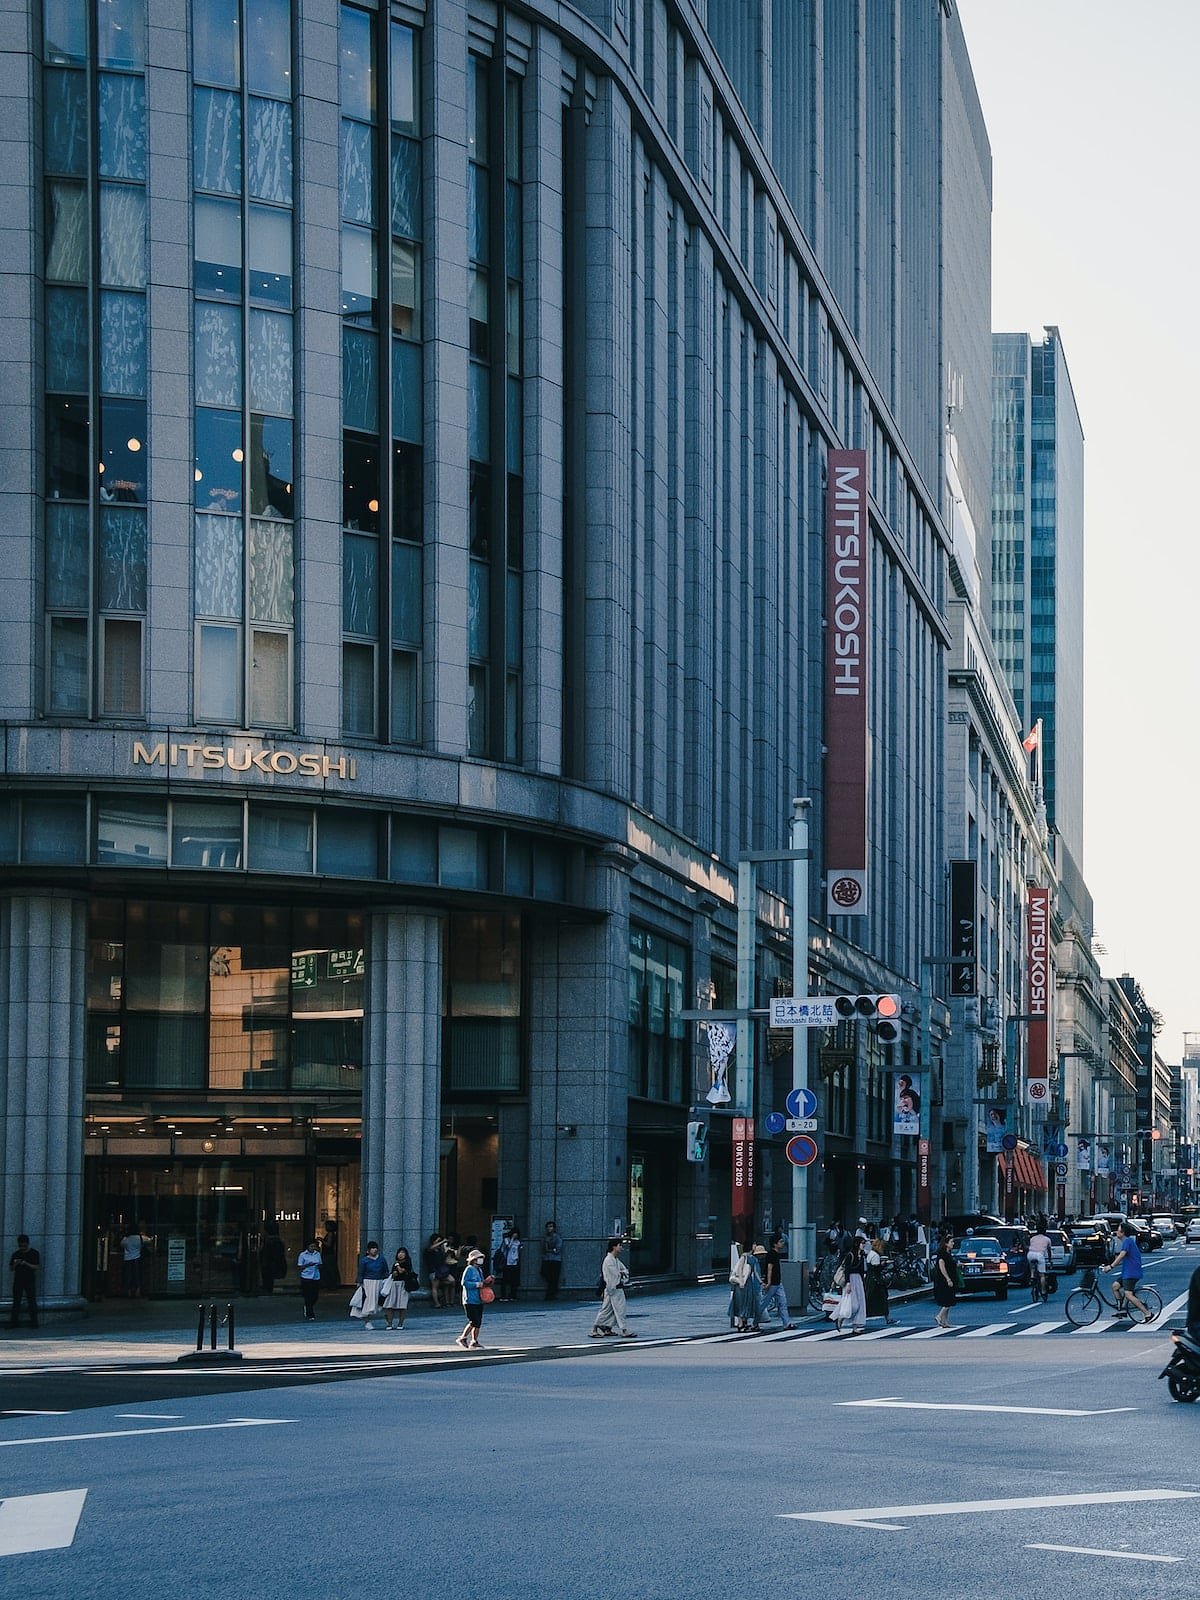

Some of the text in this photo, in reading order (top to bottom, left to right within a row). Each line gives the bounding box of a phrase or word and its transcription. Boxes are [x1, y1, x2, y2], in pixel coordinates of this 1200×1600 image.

[835, 467, 860, 695] MITSUKOSHI
[133, 741, 358, 780] MITSUKOSHI
[1032, 897, 1046, 1015] MITSUKOSH
[776, 1004, 832, 1017] 日本橋北詰
[735, 1142, 744, 1187] TOKYO 2020
